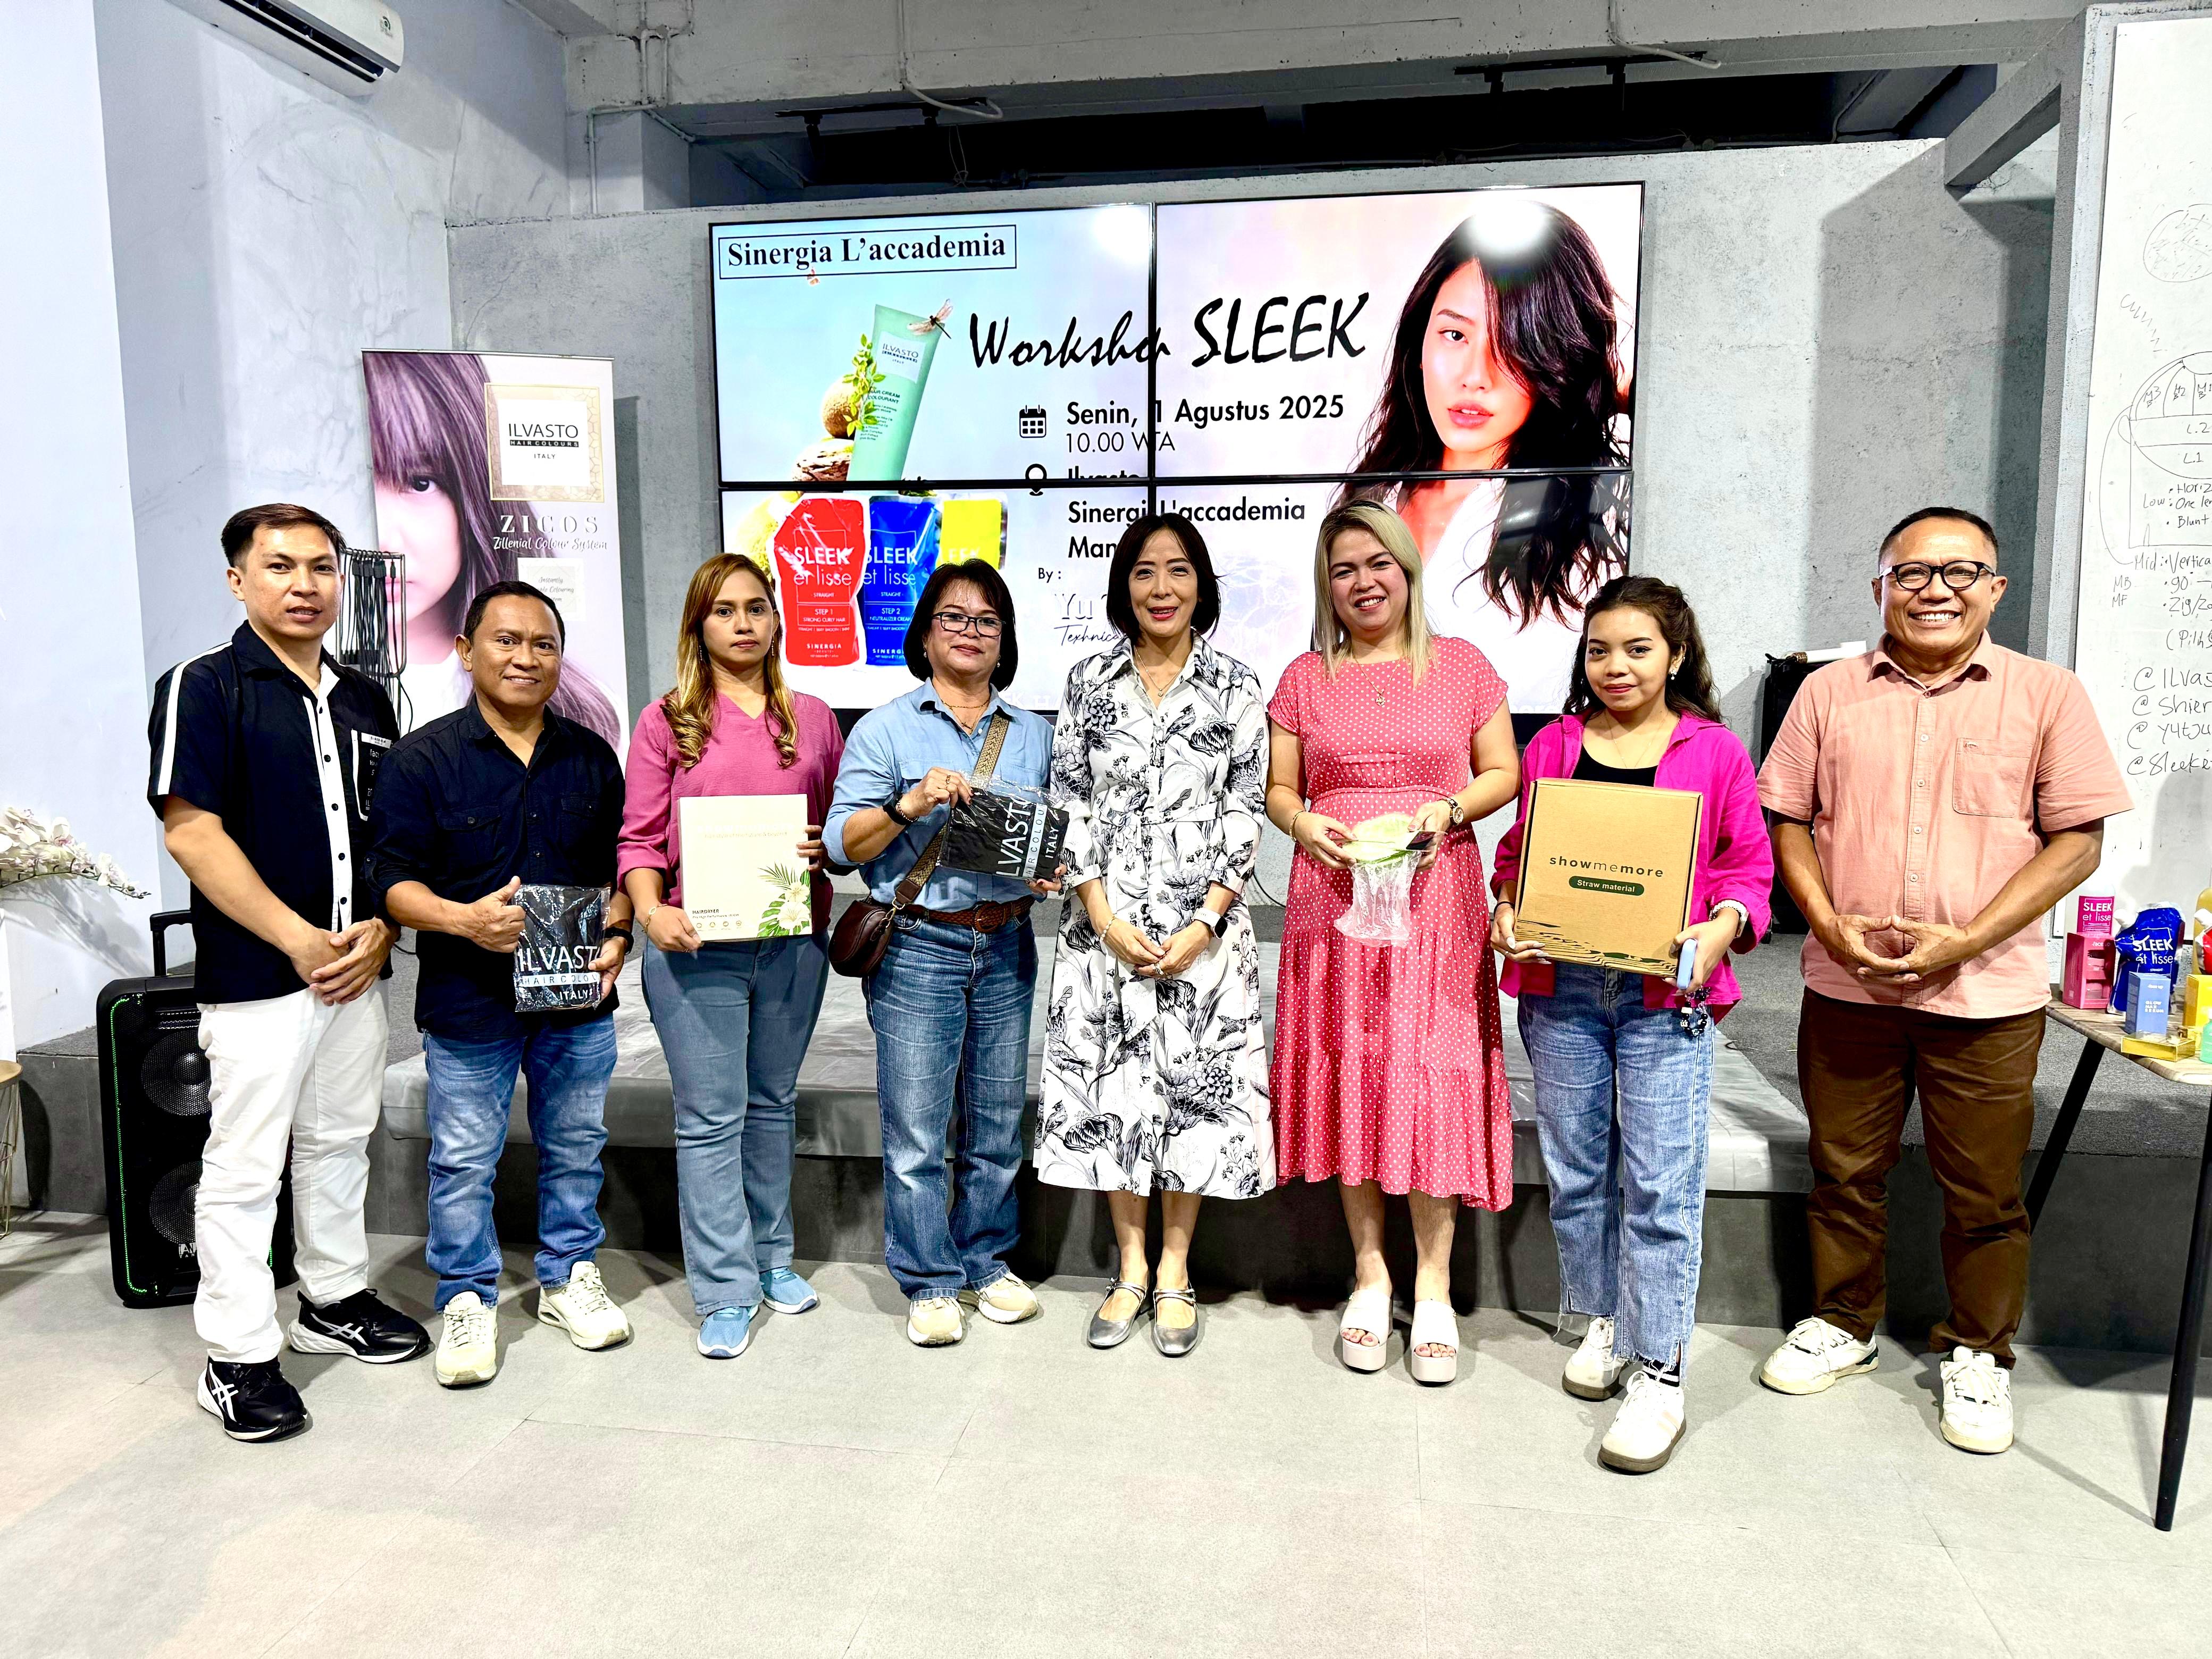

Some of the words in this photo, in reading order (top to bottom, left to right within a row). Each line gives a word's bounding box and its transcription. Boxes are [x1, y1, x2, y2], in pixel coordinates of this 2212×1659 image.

[727, 238, 832, 271] Sinergia
[841, 233, 1006, 263] L'accademia
[1191, 292, 1370, 368] SLEEK
[883, 343, 918, 358] ILVASTO
[1067, 400, 1137, 428] Senin,
[1175, 398, 1269, 429] Agustus
[1279, 395, 1344, 419] 2025
[509, 423, 579, 438] ILVASTO
[1066, 432, 1124, 453] 10.00
[2176, 498, 2196, 509] One
[1068, 500, 1147, 527] Sinergi
[2178, 514, 2210, 528] Blunt
[500, 515, 598, 534] ZICOS
[493, 537, 532, 550] Zillenial
[535, 538, 569, 550] Colour
[572, 538, 607, 552] System
[1068, 536, 1117, 558] Man
[794, 547, 851, 565] SLEEK
[867, 546, 918, 565] SLEEK
[817, 565, 851, 586] lisse
[863, 568, 877, 585] et
[884, 564, 916, 585] lisse
[1038, 568, 1054, 582] By
[1054, 624, 1120, 646] Texhnica
[996, 797, 1032, 876] LVASTO
[1030, 809, 1045, 852] COLOU
[1045, 827, 1059, 859] ITALY
[1026, 858, 1036, 876] AIR
[1549, 856, 1664, 878] showmemore
[1577, 879, 1600, 889] Straw
[1602, 882, 1635, 893] material
[2083, 902, 2112, 911] SLEEK
[2096, 911, 2112, 921] lisse
[2133, 939, 2174, 951] SLEEK
[2151, 951, 2173, 964] lisse
[560, 973, 597, 984] COLOU
[559, 991, 589, 1001] ITALY
